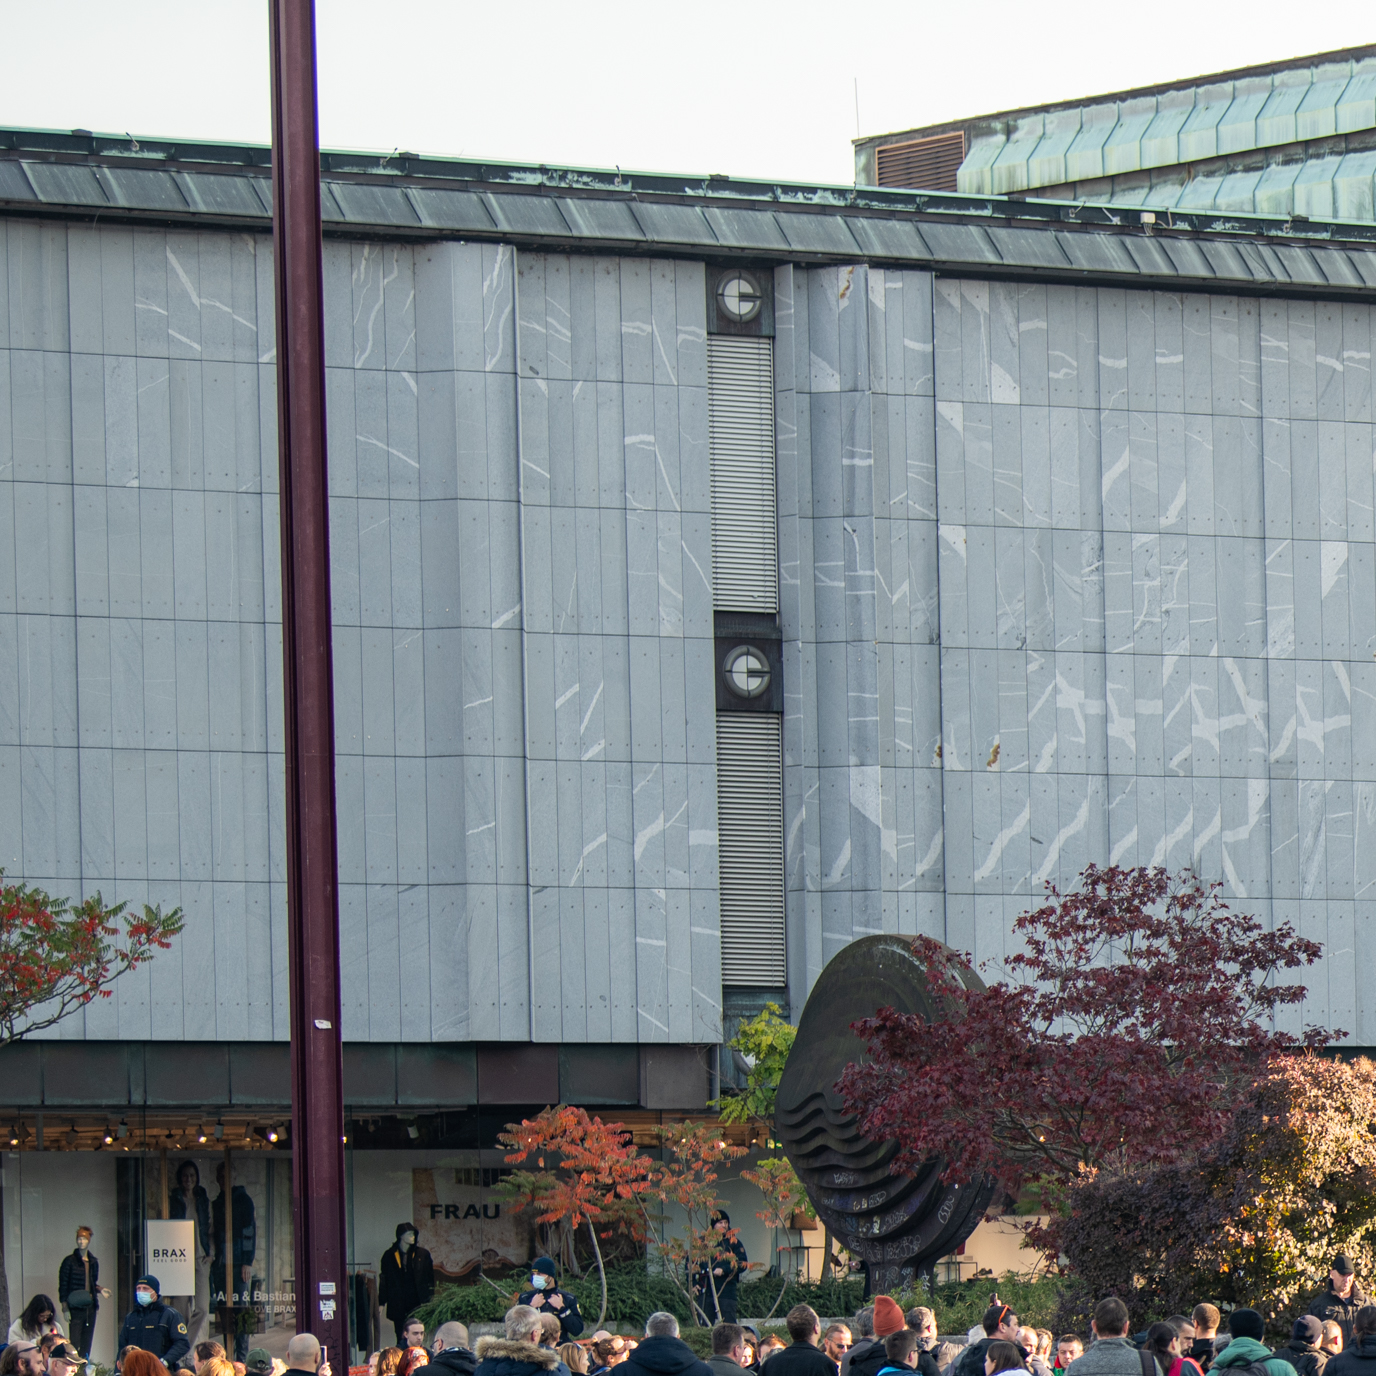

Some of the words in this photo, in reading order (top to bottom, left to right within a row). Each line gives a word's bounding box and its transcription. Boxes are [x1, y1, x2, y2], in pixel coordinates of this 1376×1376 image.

[430, 1203, 501, 1219] FRAU
[153, 1248, 187, 1258] BRAX
[242, 1290, 251, 1302] &
[253, 1290, 296, 1302] Bastian
[274, 1305, 297, 1313] BRAX
